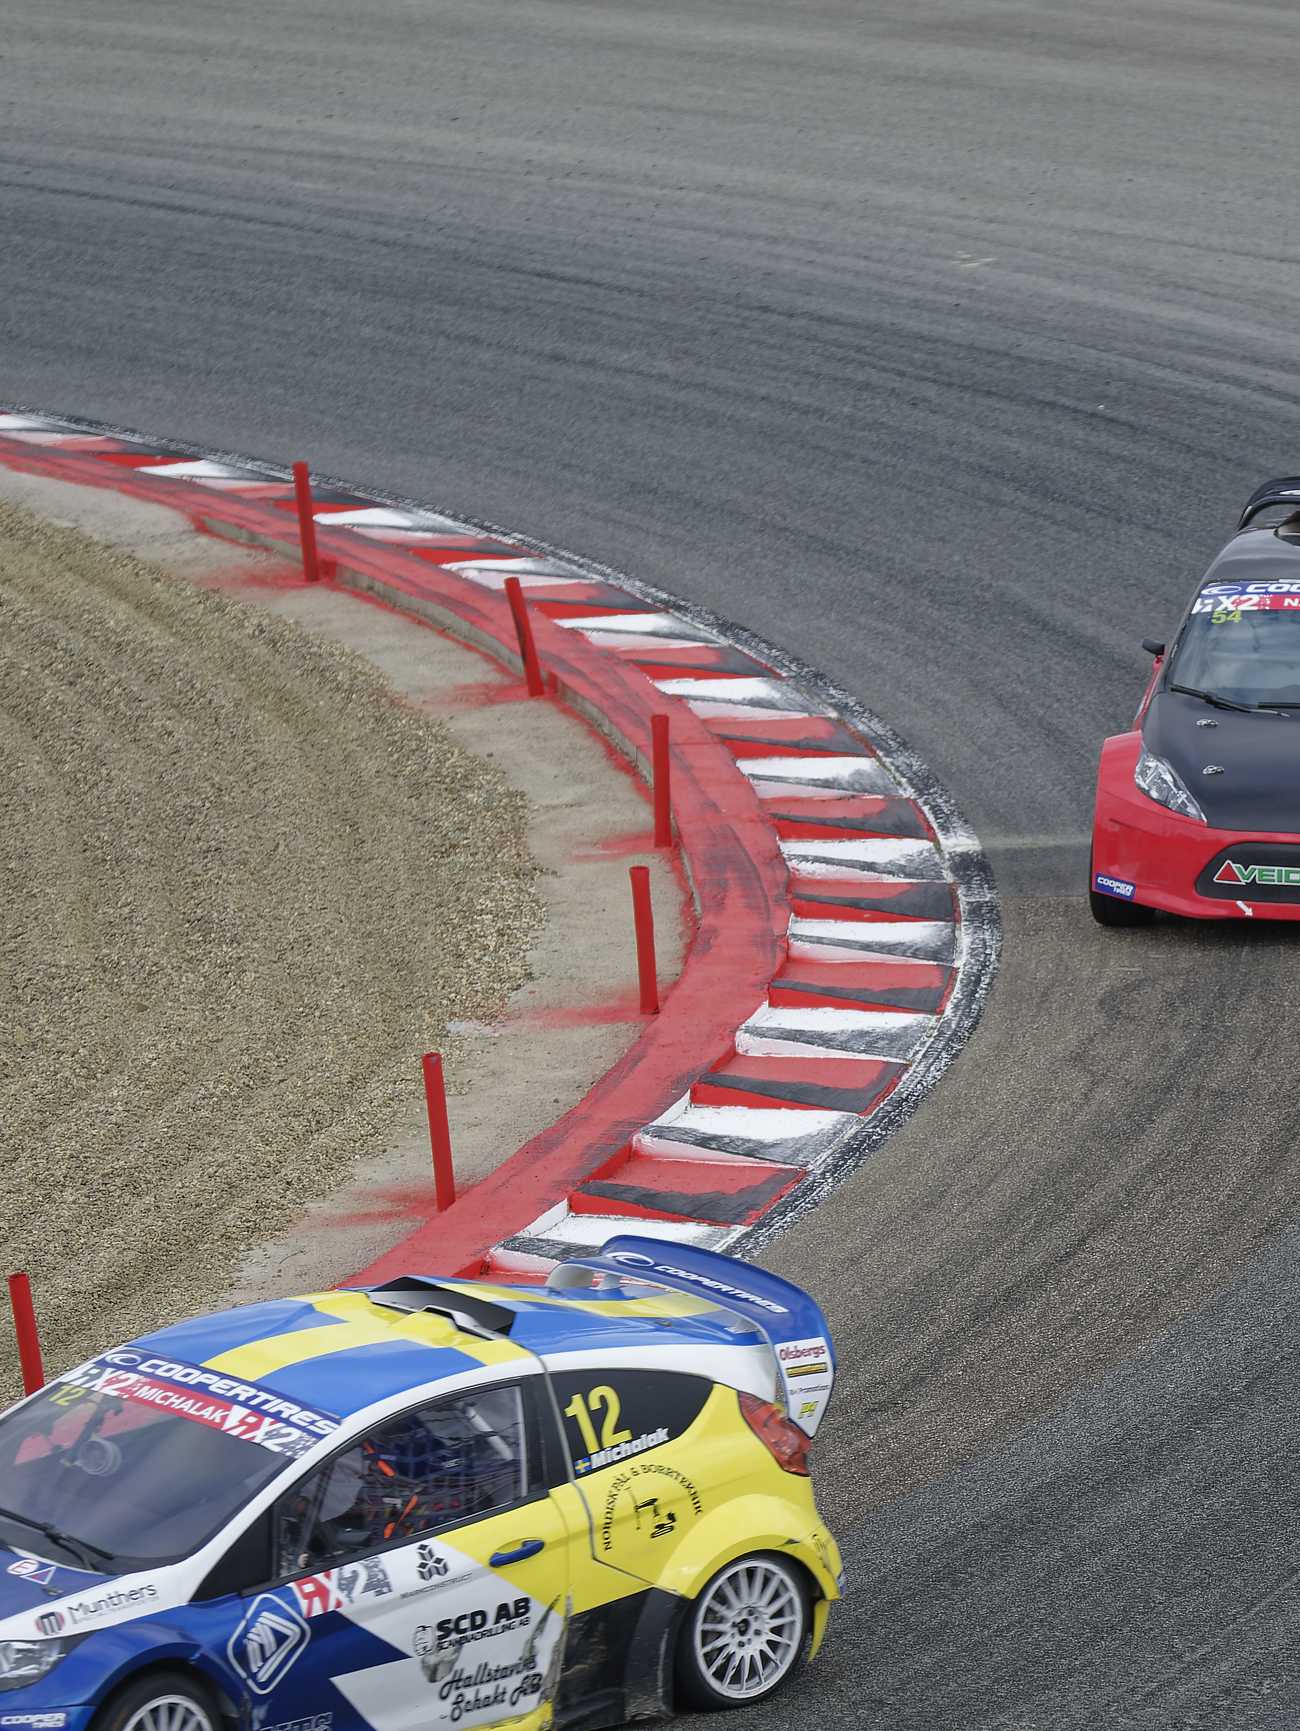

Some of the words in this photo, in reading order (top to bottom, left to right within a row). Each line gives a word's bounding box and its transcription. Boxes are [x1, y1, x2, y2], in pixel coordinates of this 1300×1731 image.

[1211, 609, 1242, 625] 54
[654, 1264, 789, 1314] COOPERTIRES
[779, 1345, 826, 1361] Olsbergs
[50, 1384, 89, 1406] 12
[134, 1385, 230, 1423] MICHALAK
[137, 1359, 340, 1436] COOPERTIRES
[564, 1385, 632, 1454] 12
[591, 1428, 670, 1469] Michalak
[66, 1584, 157, 1625] Munthers
[436, 1609, 487, 1641] SCD
[494, 1597, 531, 1625] AB
[1, 1713, 67, 1725] COOPER
